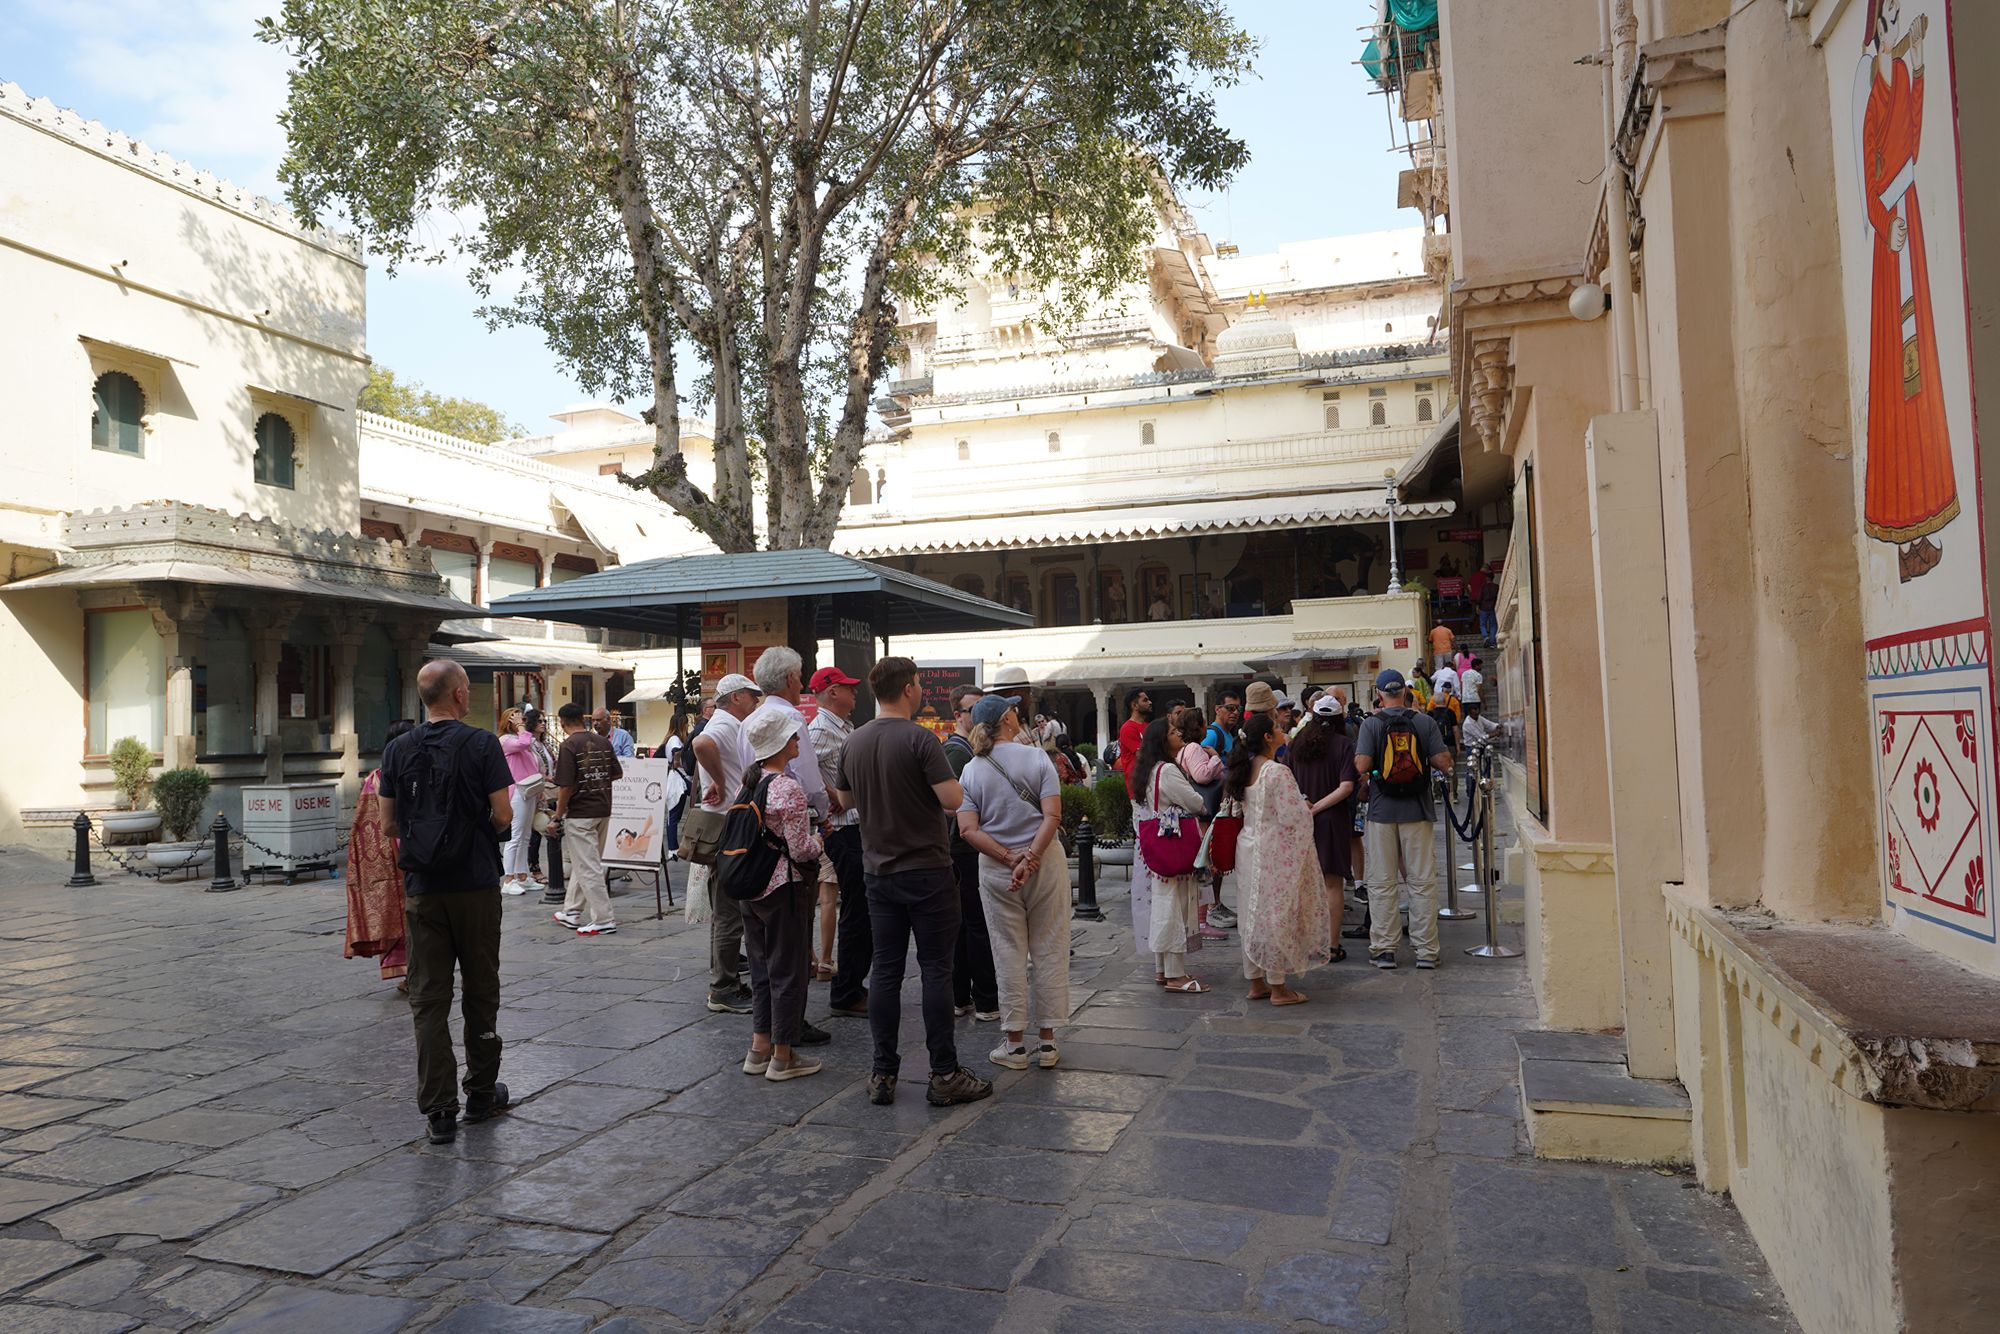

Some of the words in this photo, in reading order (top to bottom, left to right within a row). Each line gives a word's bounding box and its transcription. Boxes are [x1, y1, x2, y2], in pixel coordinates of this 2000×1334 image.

[840, 617, 870, 642] ECHOES
[927, 670, 940, 678] Dal
[248, 799, 265, 811] USE
[268, 799, 282, 811] ME
[295, 797, 316, 810] USE
[317, 796, 331, 808] ME
